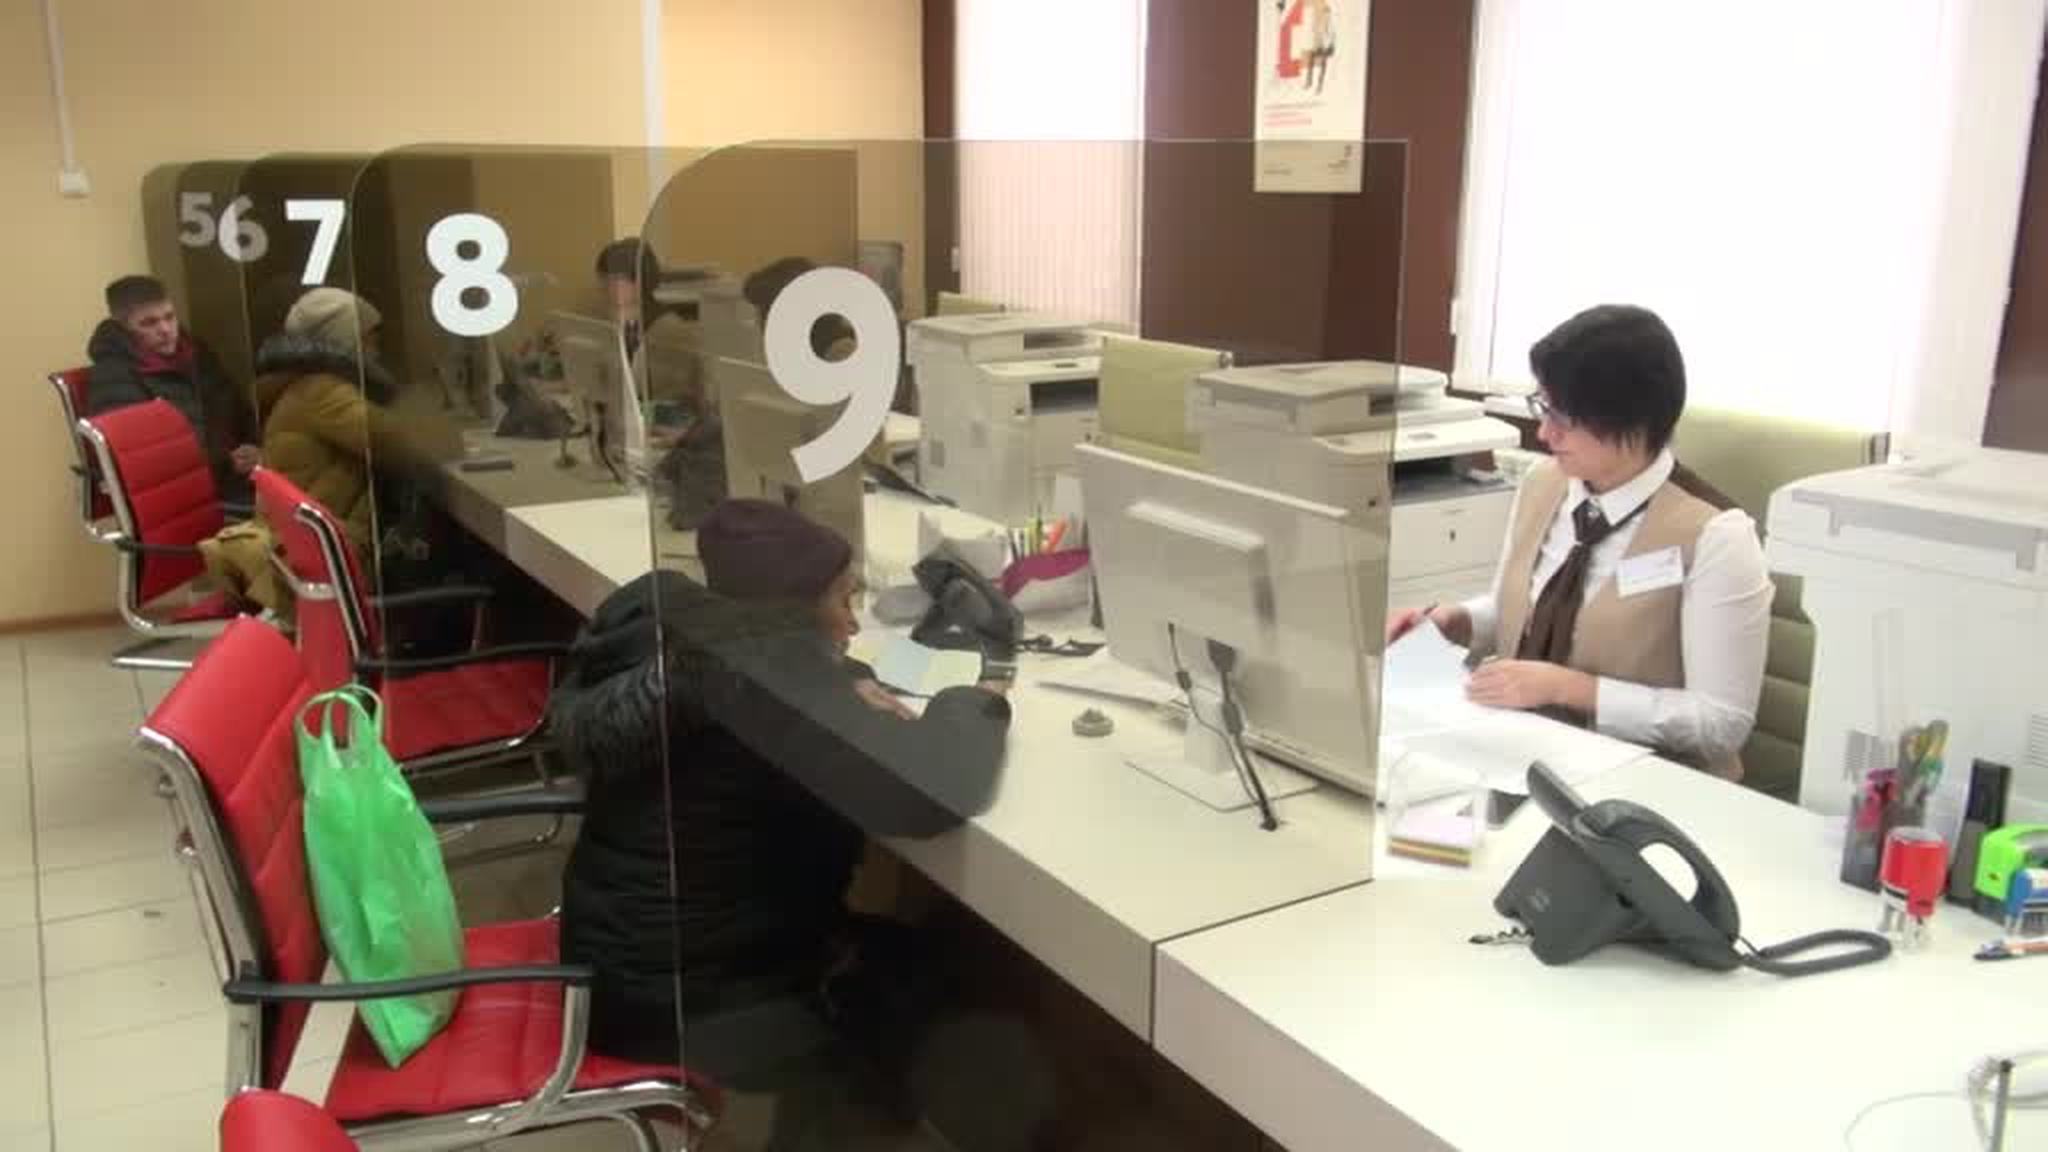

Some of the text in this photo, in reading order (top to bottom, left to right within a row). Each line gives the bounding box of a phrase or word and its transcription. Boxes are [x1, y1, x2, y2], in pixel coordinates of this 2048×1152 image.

[179, 192, 216, 248] 5
[218, 195, 269, 262] 6
[284, 199, 347, 286] 7
[426, 212, 519, 337] 8
[765, 266, 900, 484] 9
